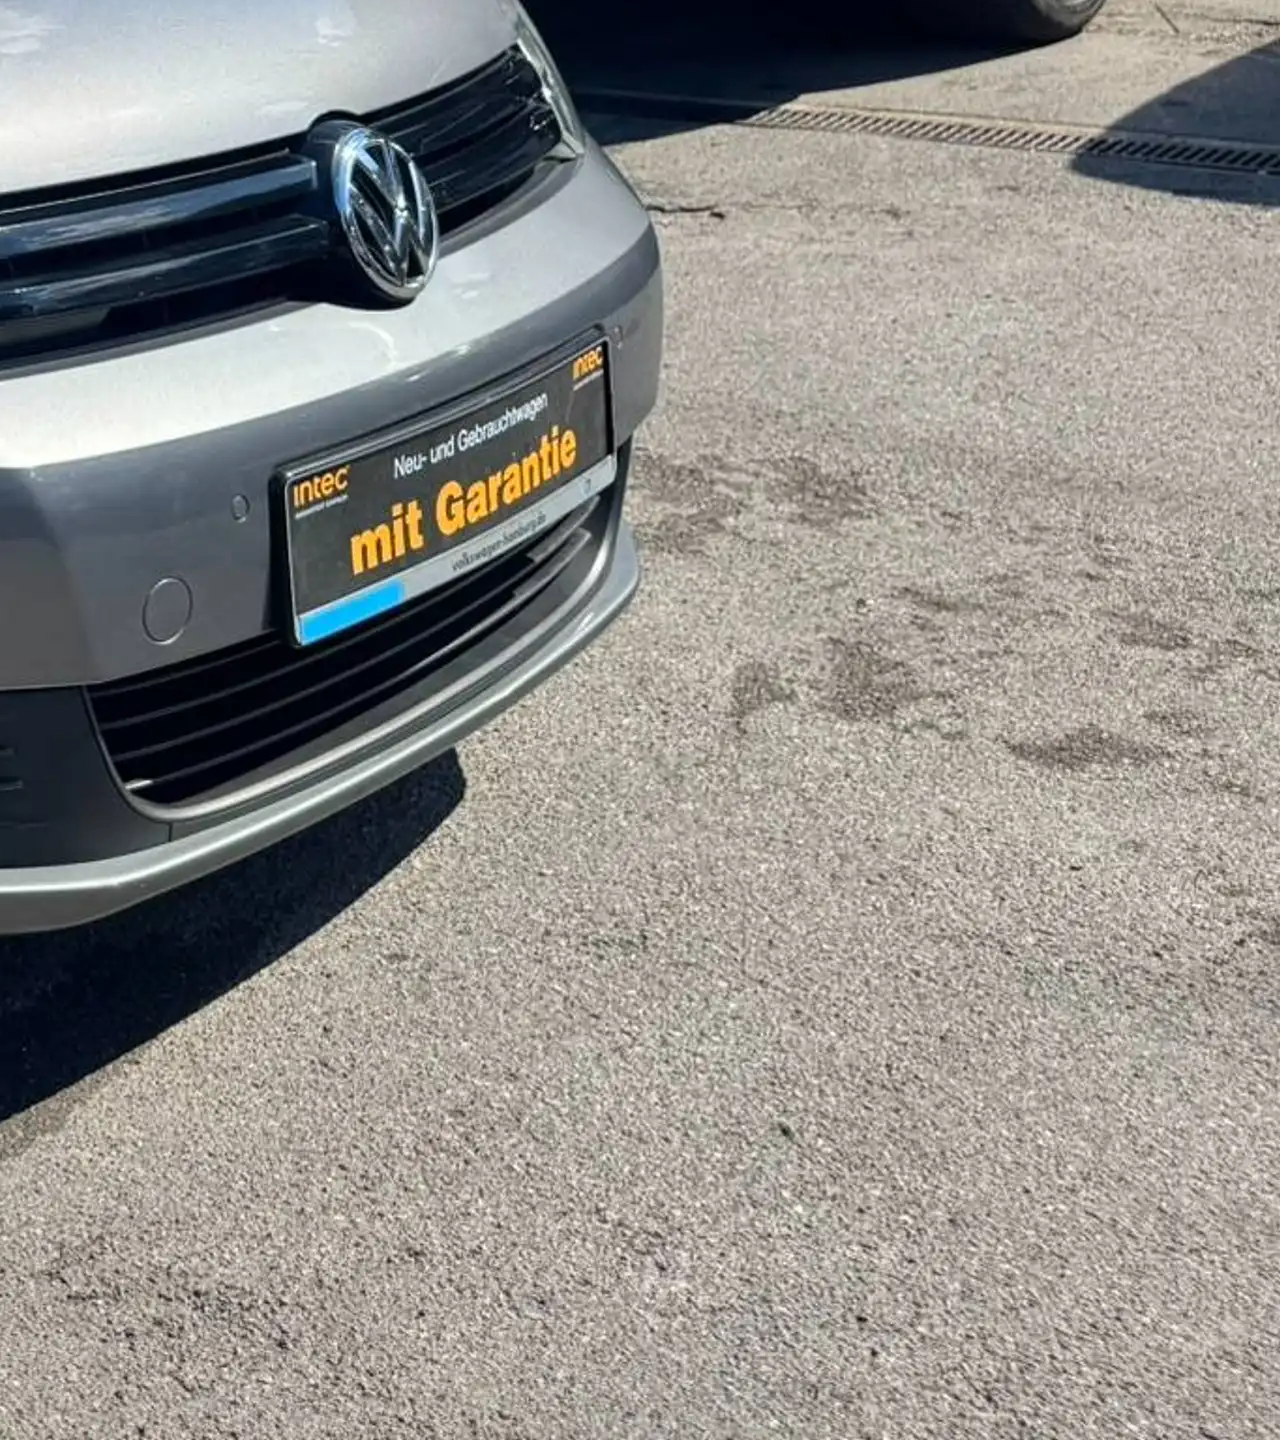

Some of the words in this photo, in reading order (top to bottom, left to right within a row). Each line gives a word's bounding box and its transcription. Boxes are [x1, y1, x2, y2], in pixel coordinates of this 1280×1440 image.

[393, 454, 427, 479] Neu-
[430, 434, 455, 463] und
[457, 392, 548, 452] Gebrauchtwagen
[350, 498, 425, 576] mit
[436, 426, 577, 536] Garantie
